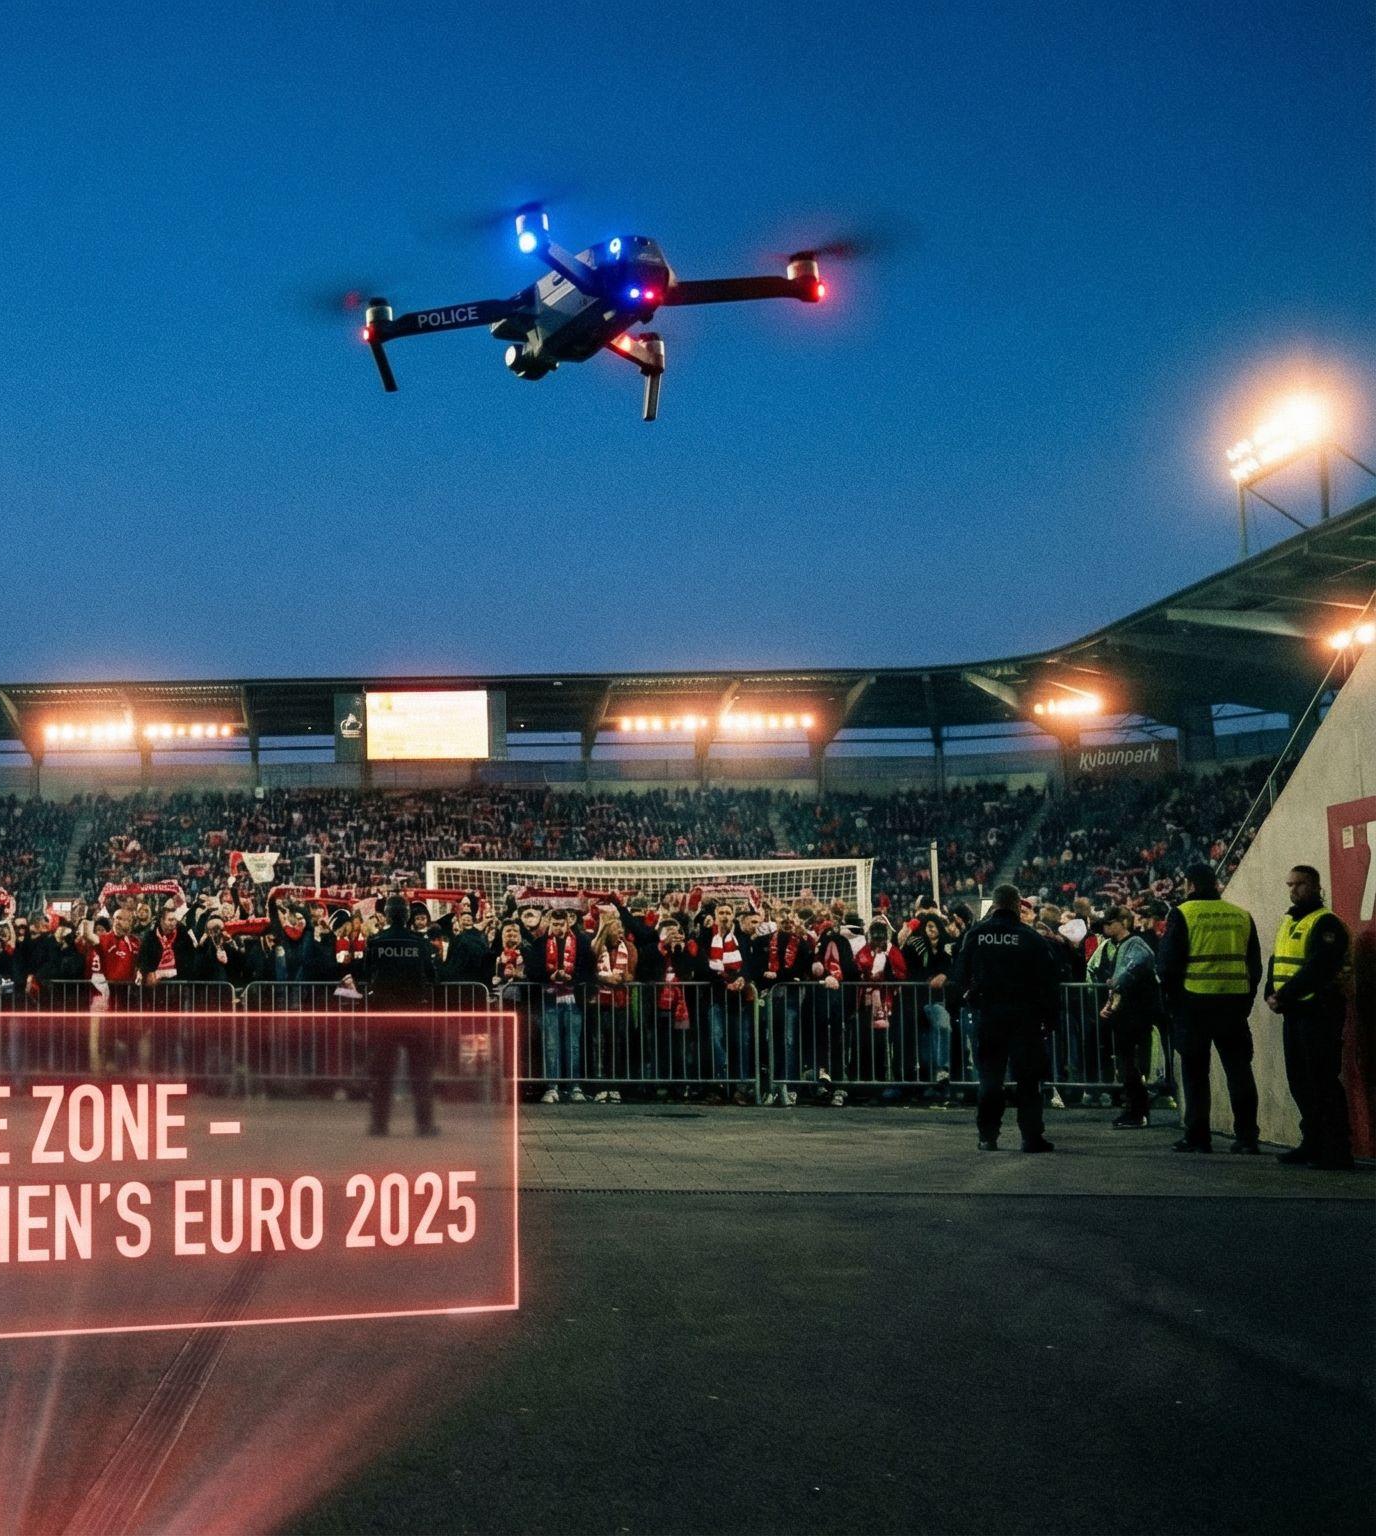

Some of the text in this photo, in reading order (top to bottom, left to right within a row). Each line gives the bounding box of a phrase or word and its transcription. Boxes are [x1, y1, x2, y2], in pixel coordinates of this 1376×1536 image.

[417, 306, 480, 329] POLICE
[977, 932, 1019, 946] POLICE
[30, 1083, 188, 1165] ZONE
[174, 1175, 324, 1256] EURO
[345, 1170, 478, 1248] 2025
